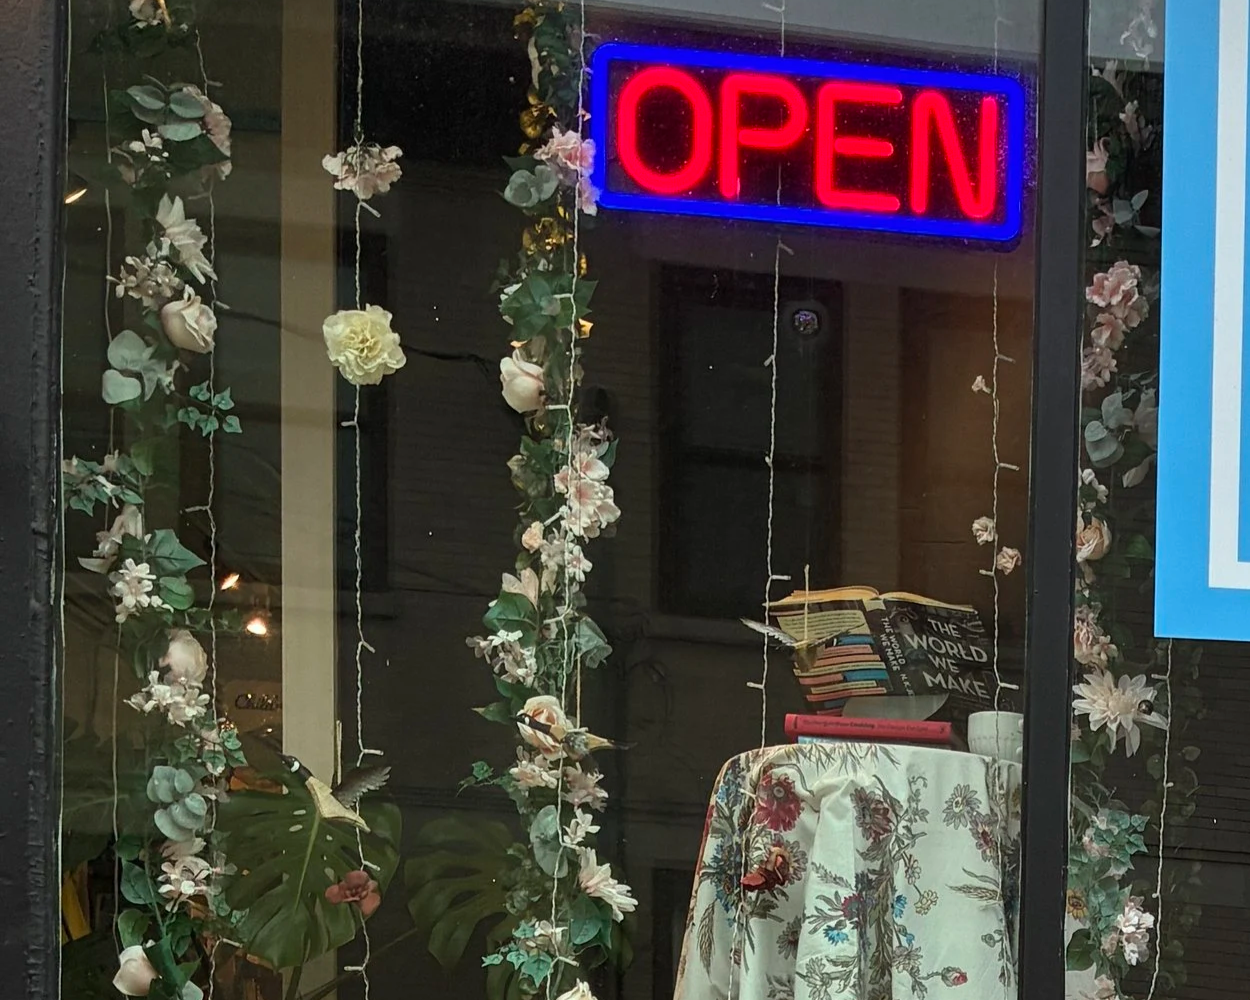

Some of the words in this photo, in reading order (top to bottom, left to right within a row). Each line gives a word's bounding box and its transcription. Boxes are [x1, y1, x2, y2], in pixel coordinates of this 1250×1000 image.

[616, 65, 999, 221] OPEN
[881, 617, 894, 635] THE
[927, 618, 962, 638] THE
[904, 633, 988, 663] WORLD
[927, 654, 960, 673] WE
[922, 671, 991, 699] MAKE
